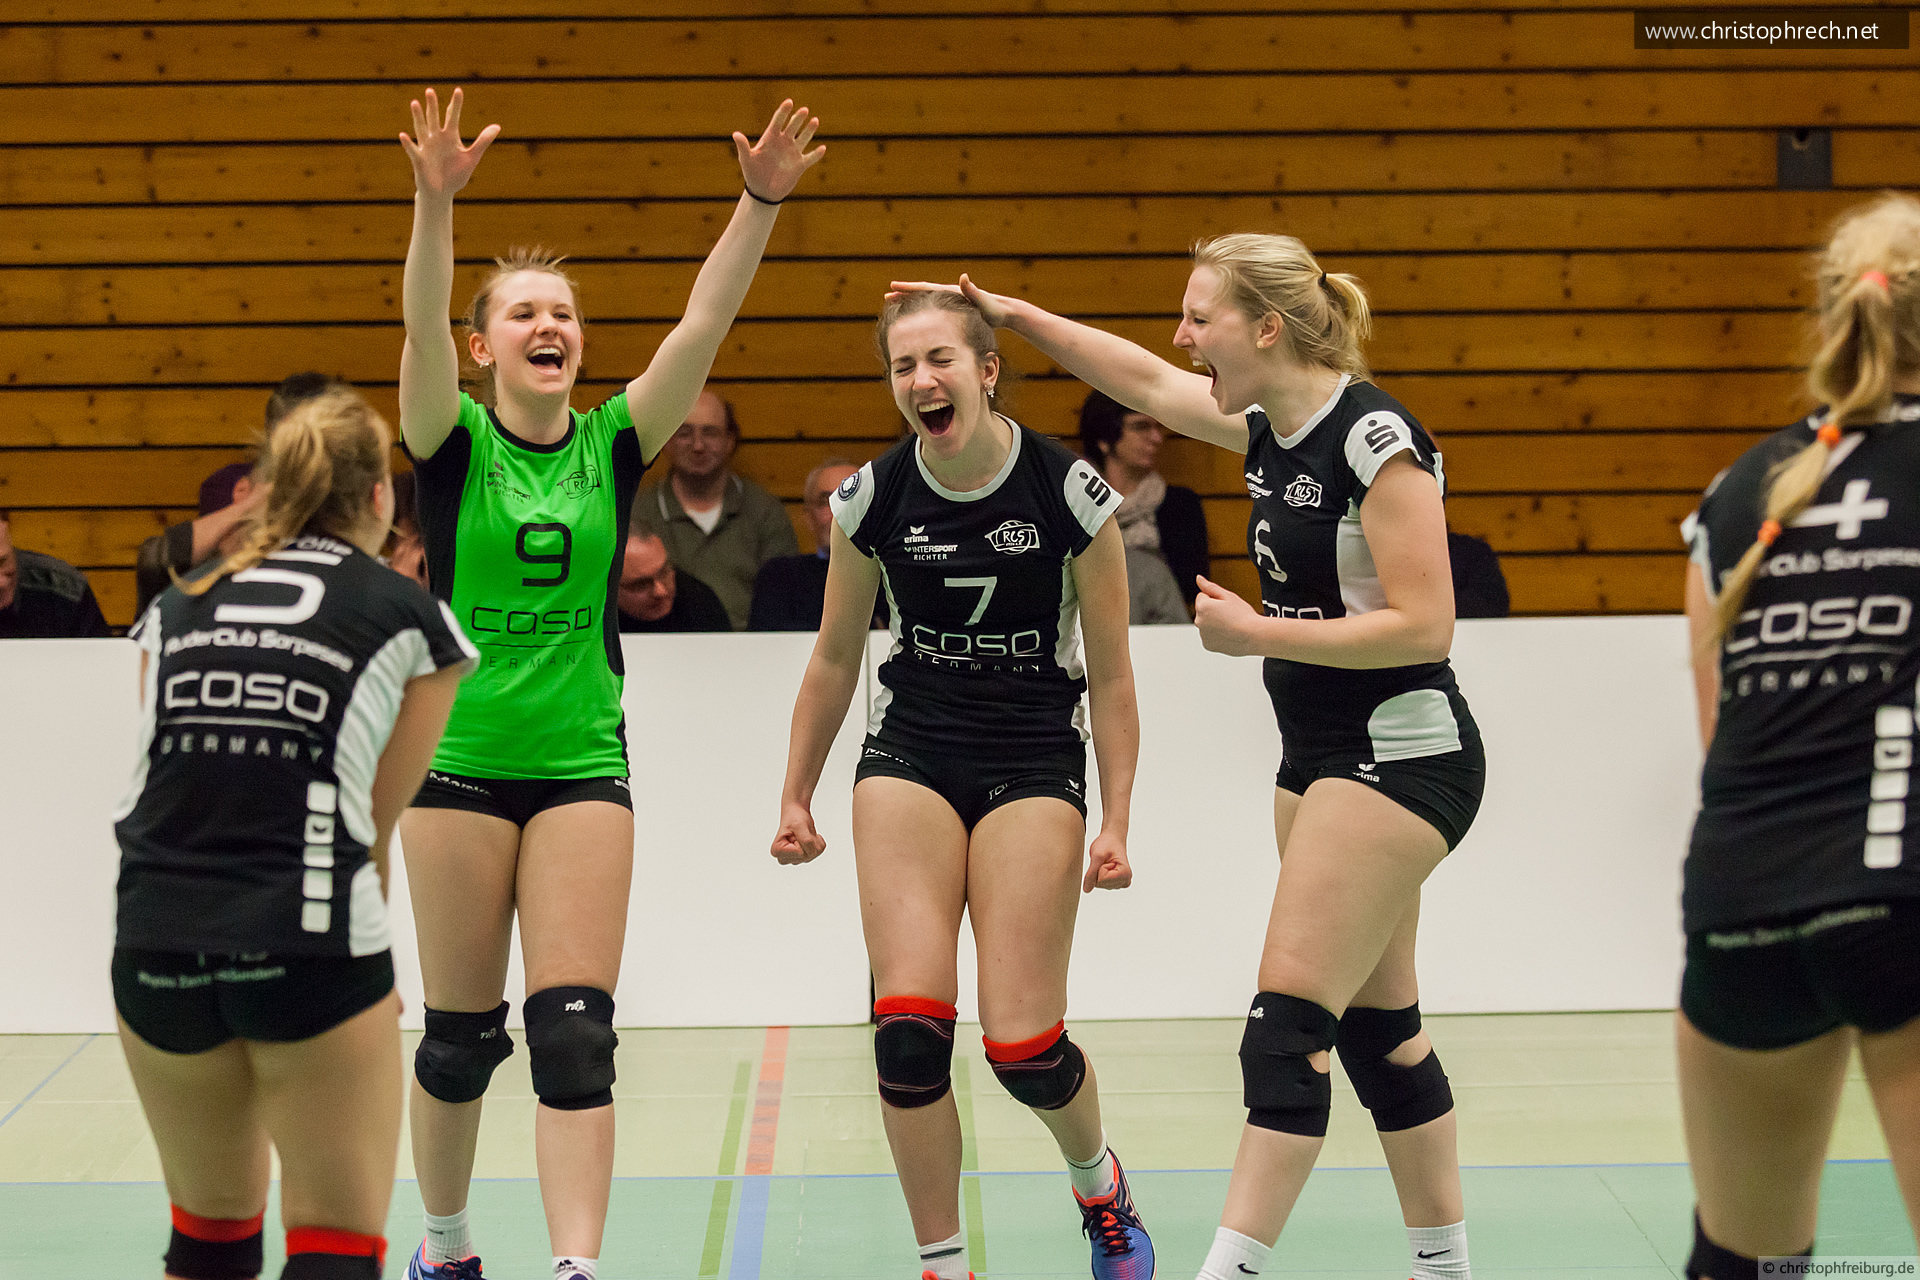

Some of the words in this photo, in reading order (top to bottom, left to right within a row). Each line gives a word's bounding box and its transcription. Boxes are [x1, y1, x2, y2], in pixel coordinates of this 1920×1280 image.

[515, 522, 572, 587] 9
[904, 535, 929, 544] erima
[913, 553, 948, 561] RICHTER
[215, 551, 344, 625] 5
[944, 576, 998, 627] 7
[471, 605, 592, 636] caso
[913, 624, 1041, 657] caso
[164, 670, 330, 724] caso
